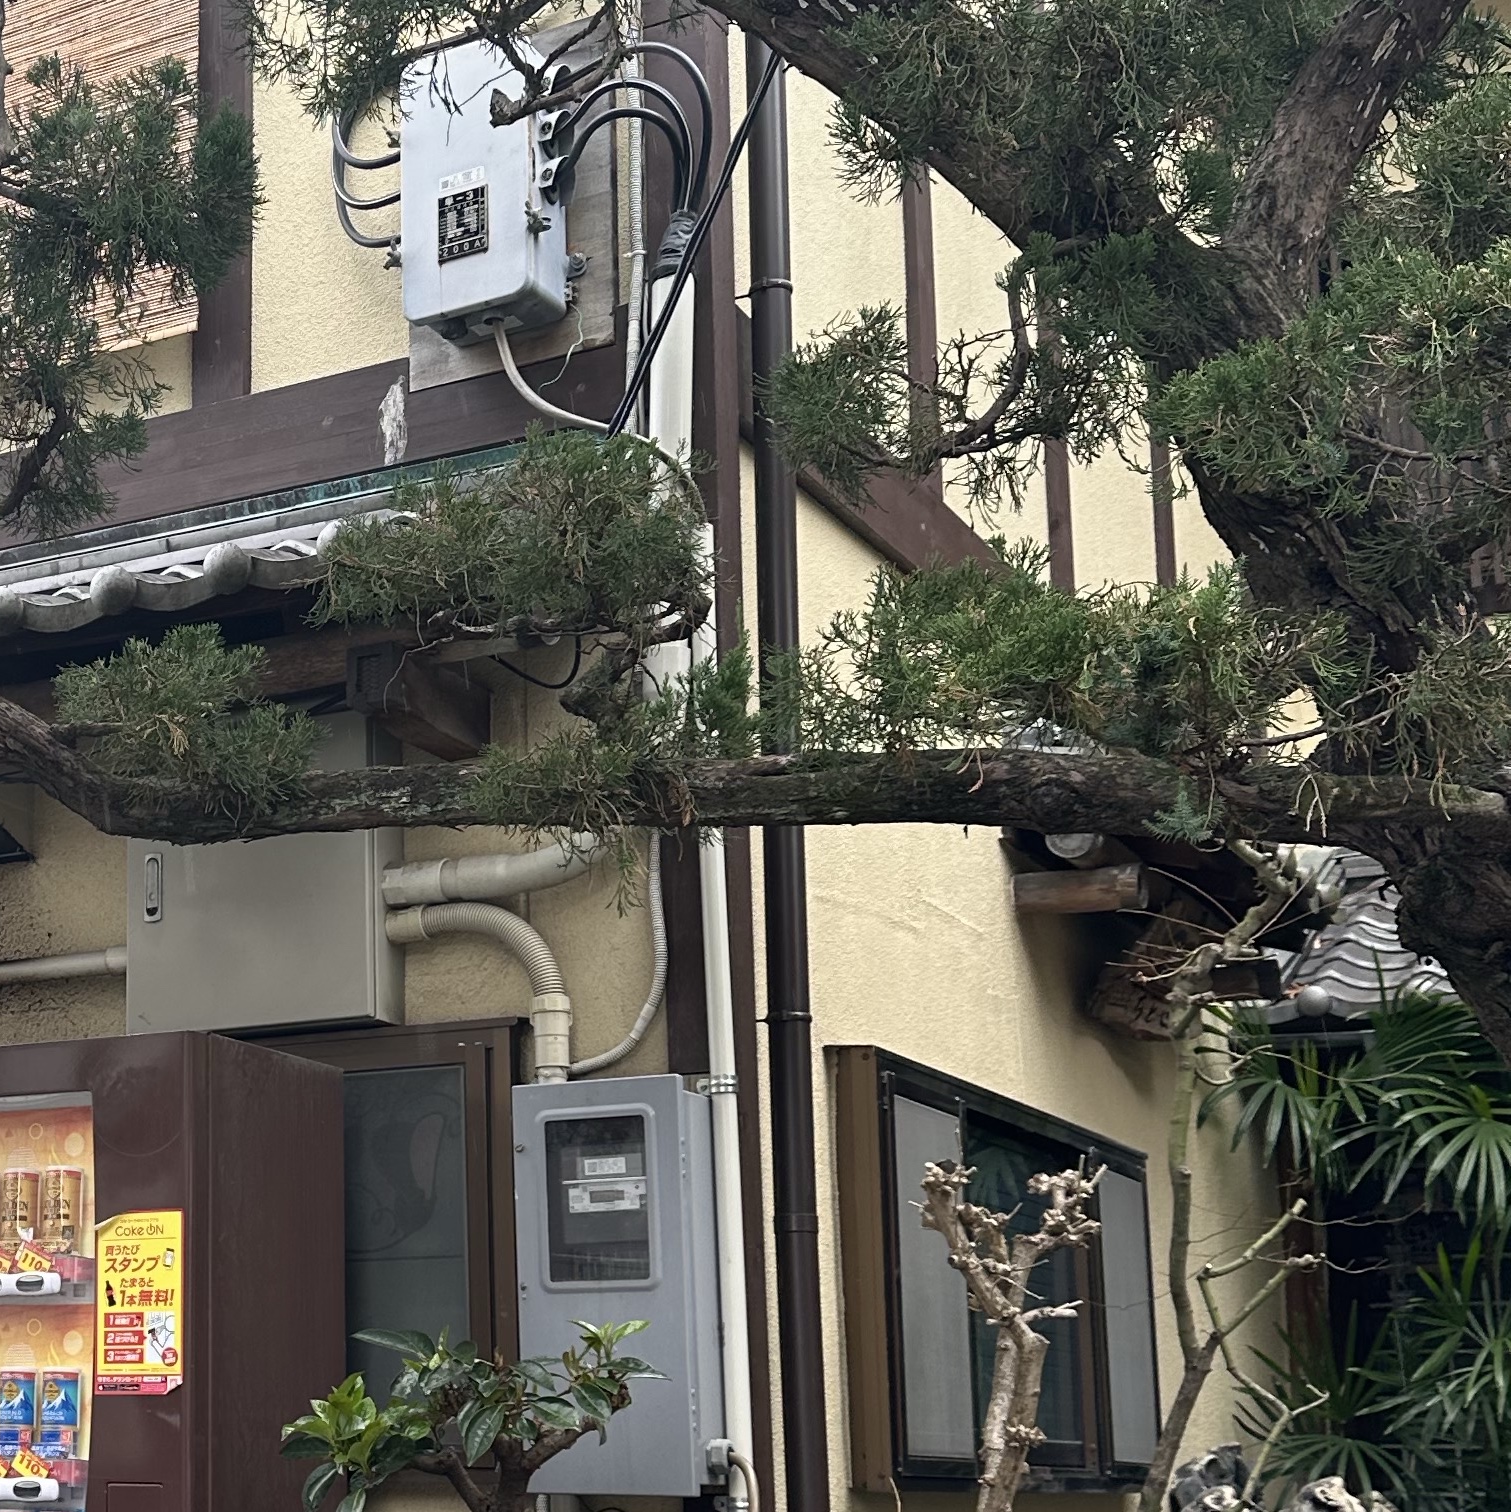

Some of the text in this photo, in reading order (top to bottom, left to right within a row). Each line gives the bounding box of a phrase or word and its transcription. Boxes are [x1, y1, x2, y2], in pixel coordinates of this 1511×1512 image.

[442, 239, 481, 257] 200A
[115, 1223, 164, 1236] Coke ON
[105, 1244, 141, 1256] 買うたび
[104, 1255, 160, 1274] スタンプ
[120, 1277, 155, 1288] たまると
[120, 1289, 175, 1307] 1本無料!
